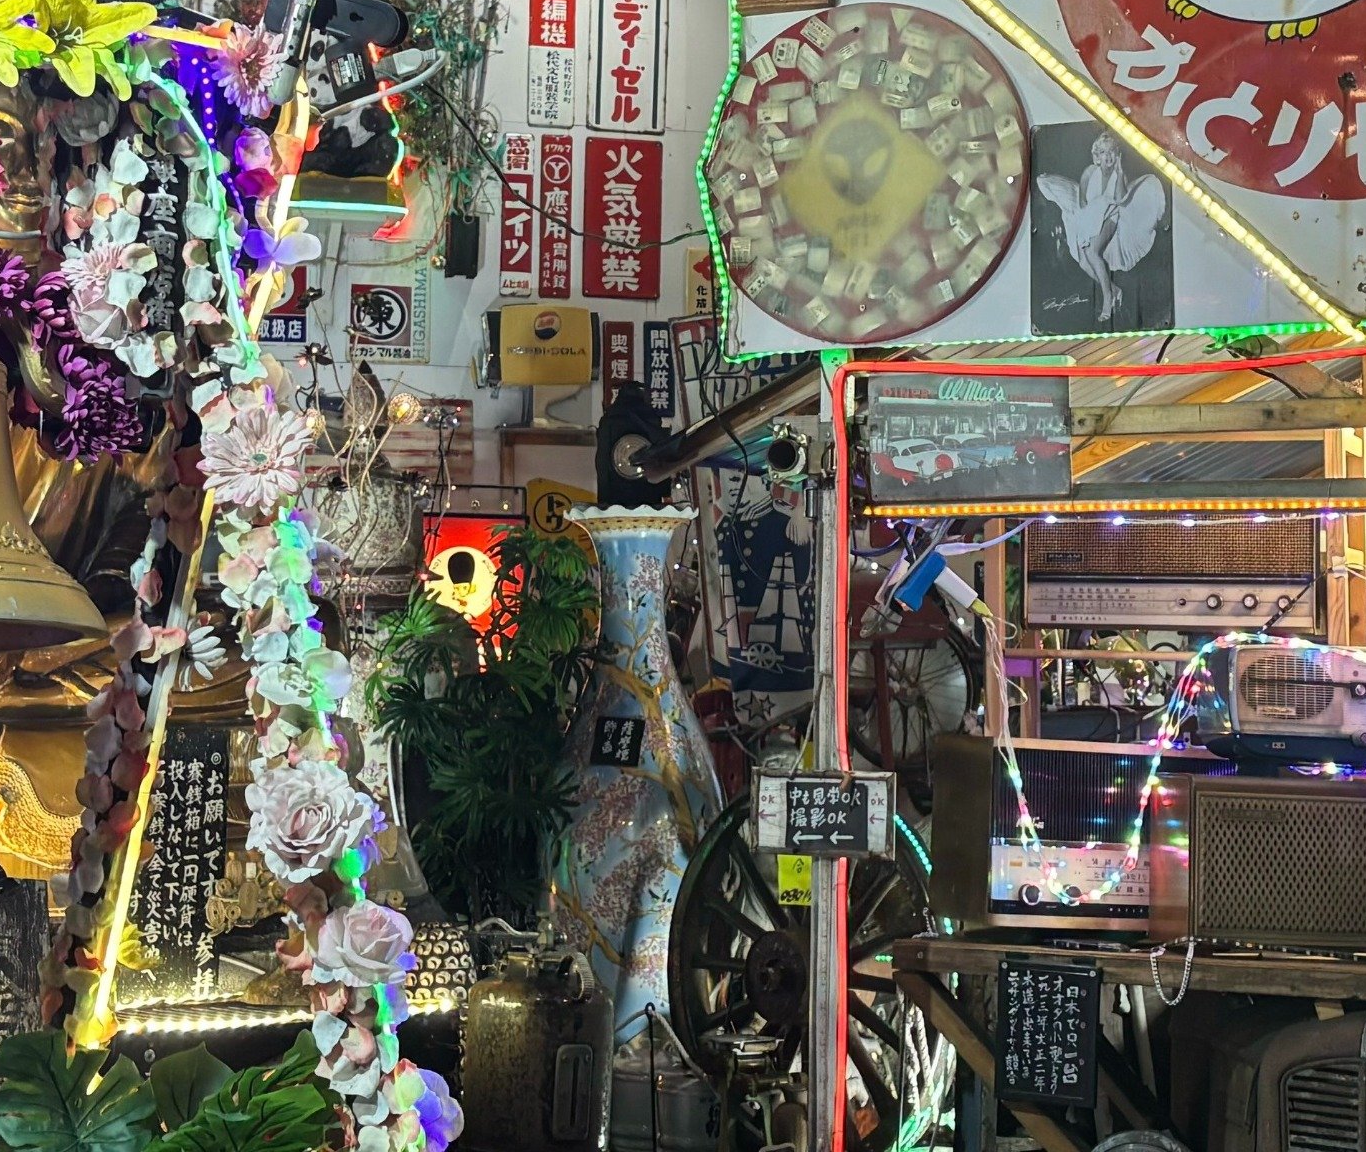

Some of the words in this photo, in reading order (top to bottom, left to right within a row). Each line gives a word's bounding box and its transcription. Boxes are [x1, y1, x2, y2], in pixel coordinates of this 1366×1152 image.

[601, 144, 644, 292] 火気厳禁
[696, 285, 708, 314] 化成
[258, 319, 303, 342] 取扱店
